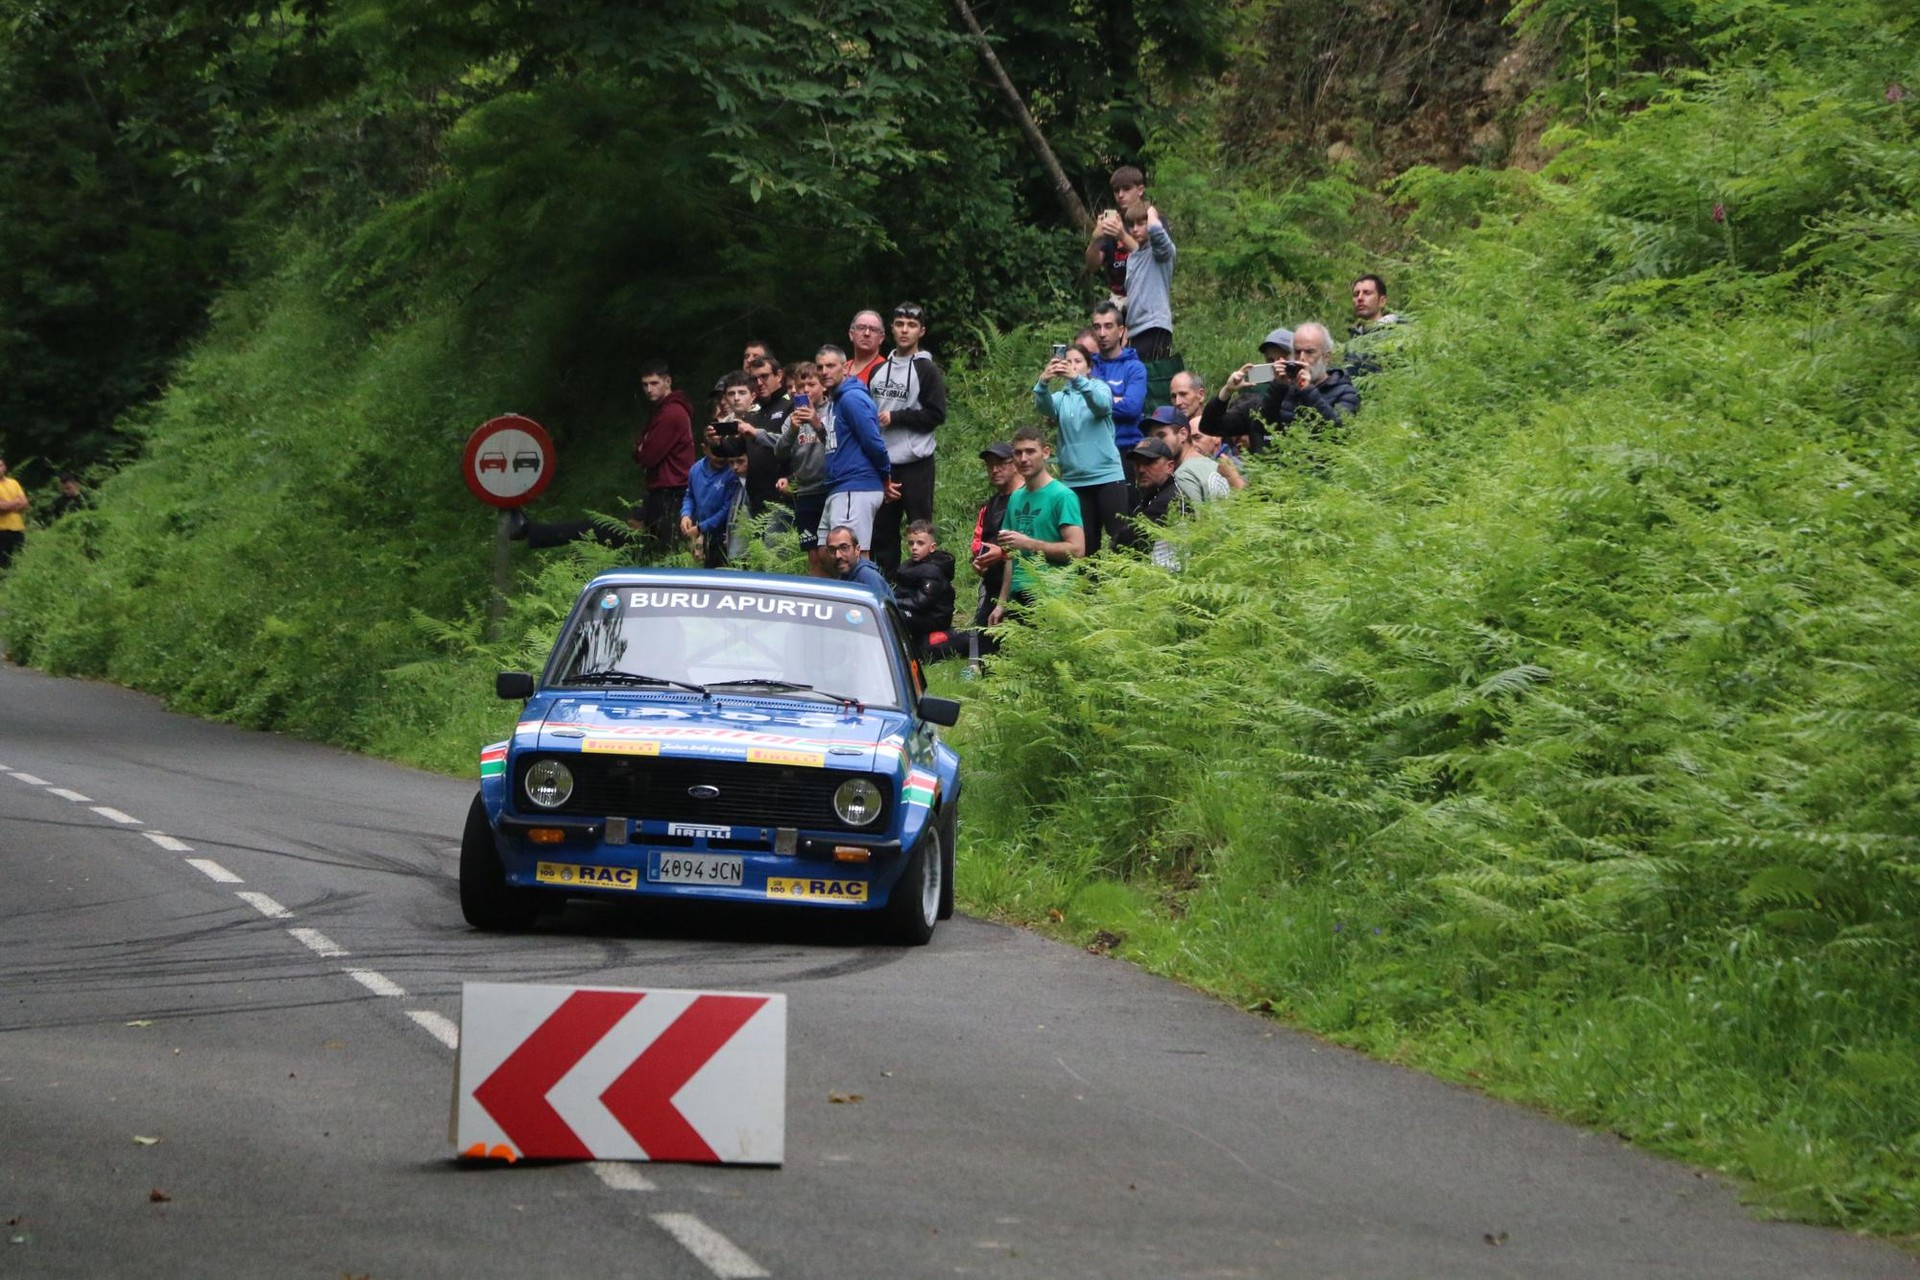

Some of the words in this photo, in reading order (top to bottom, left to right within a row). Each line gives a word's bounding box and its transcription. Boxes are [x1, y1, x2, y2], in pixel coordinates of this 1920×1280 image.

[630, 592, 709, 608] BURU
[716, 595, 833, 620] APURTU
[667, 822, 732, 839] PIRELLI
[579, 867, 633, 883] RAC
[660, 859, 704, 876] 4094
[708, 860, 741, 881] JCN
[809, 880, 862, 895] RAC
